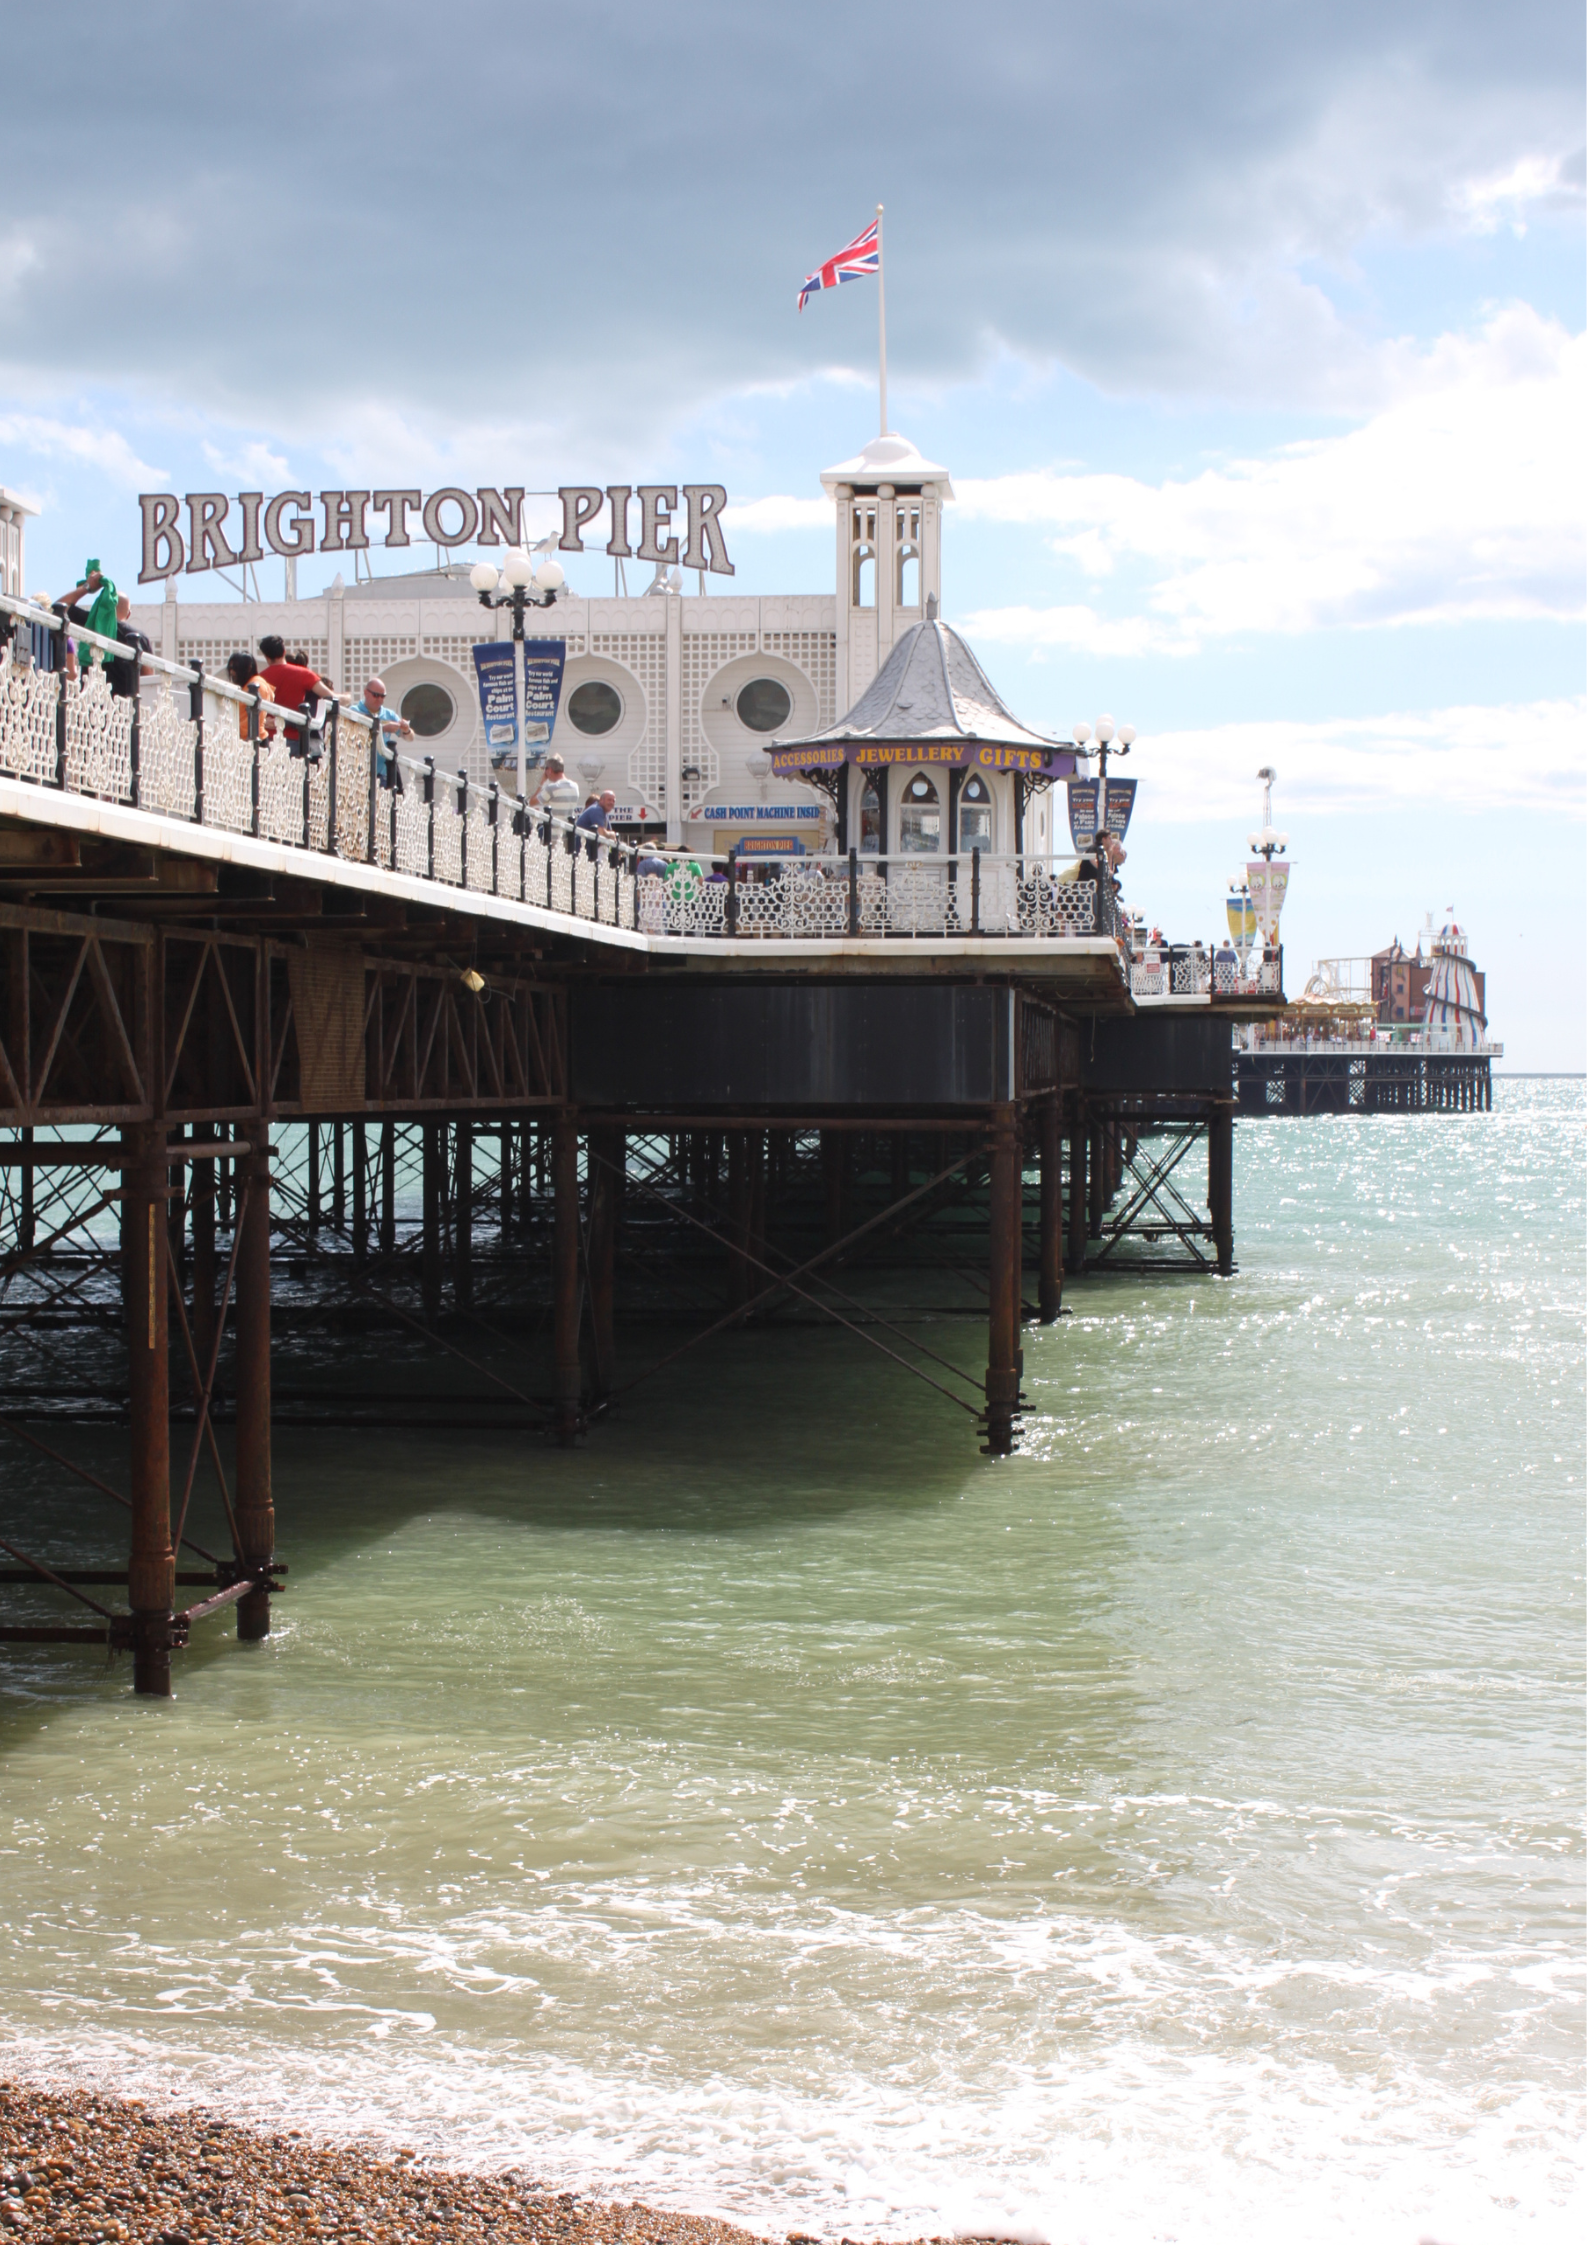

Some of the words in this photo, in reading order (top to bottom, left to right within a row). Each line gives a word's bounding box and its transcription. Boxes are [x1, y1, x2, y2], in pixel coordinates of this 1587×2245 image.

[138, 487, 525, 584] BRIGHTON
[558, 484, 735, 576] PIER
[487, 694, 514, 704] Palm
[526, 690, 553, 700] Palm
[485, 702, 514, 713] Court
[525, 700, 555, 709] Court
[486, 711, 515, 721] Restaurant
[525, 709, 554, 717] Restaurant
[773, 748, 844, 769] ACCESSORIES
[855, 747, 964, 763] JEWELLERY
[979, 747, 1042, 769] GIFTS
[704, 806, 727, 819] CASH
[728, 806, 755, 819] POINT
[756, 806, 795, 819] MACHINE
[796, 806, 820, 818] INSID
[1074, 812, 1095, 820] Palace
[744, 841, 776, 851] BRIGHTON
[778, 840, 793, 851] PIER
